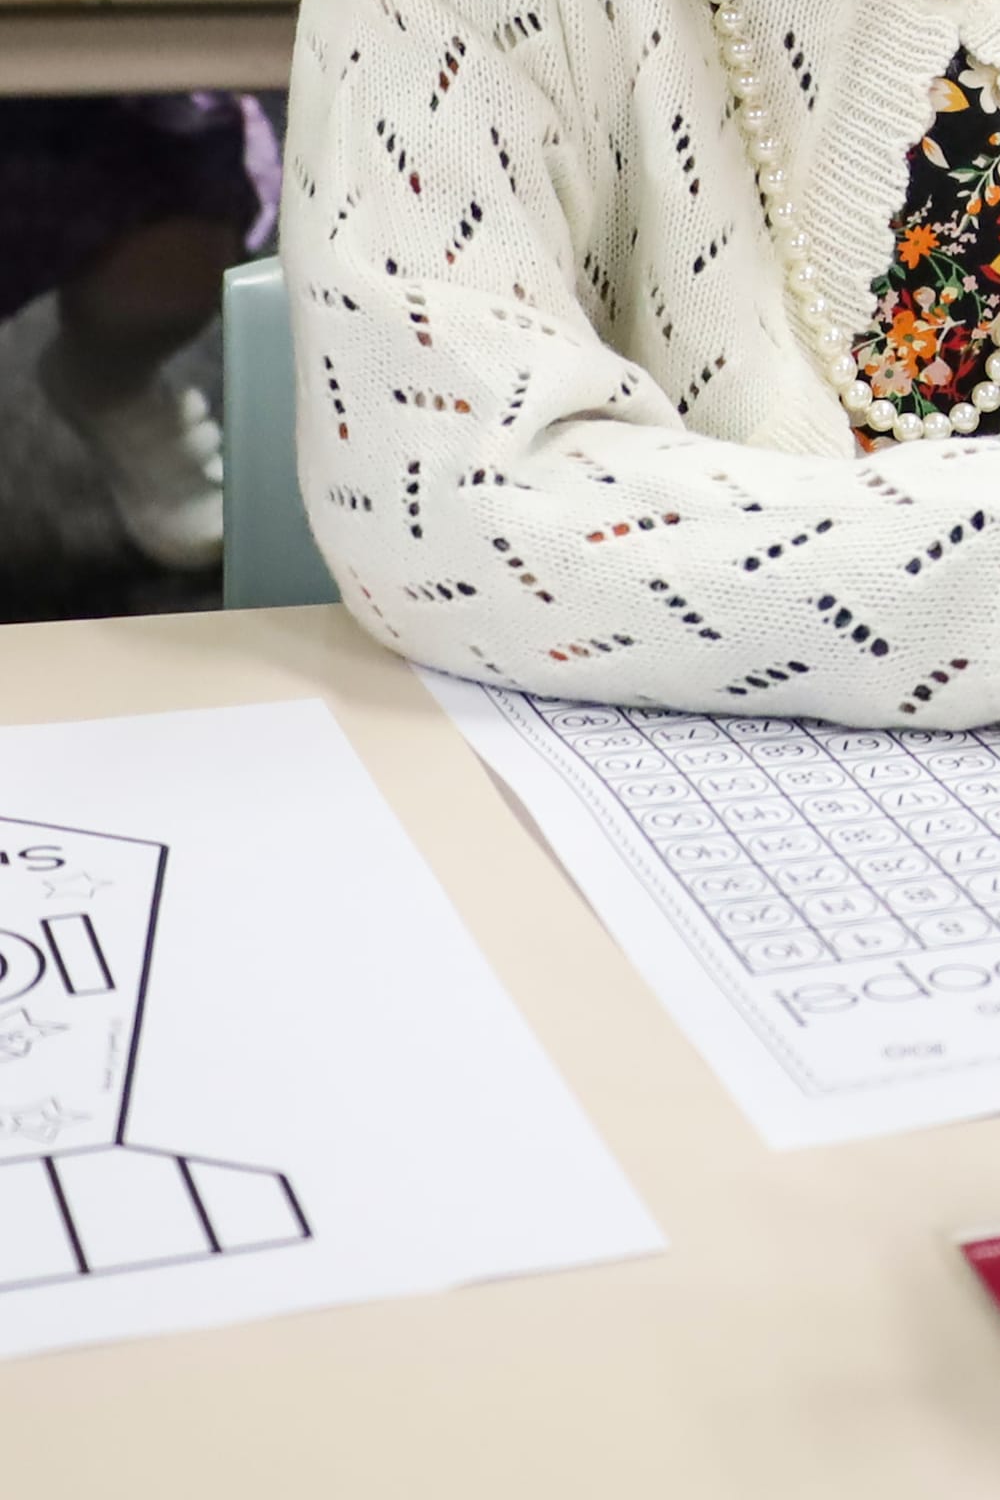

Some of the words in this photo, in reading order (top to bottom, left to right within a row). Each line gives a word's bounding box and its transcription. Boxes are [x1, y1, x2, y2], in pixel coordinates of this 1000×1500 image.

[562, 715, 609, 727] 90
[736, 720, 782, 733] 78
[660, 728, 708, 742] 79
[584, 737, 631, 748] 80
[843, 739, 880, 751] 67
[760, 744, 804, 757] 68
[604, 757, 654, 769] 70
[683, 752, 728, 765] 69
[938, 756, 984, 769] 56
[787, 771, 833, 784] 58
[871, 765, 909, 779] 57
[629, 785, 676, 798] 60
[708, 778, 756, 792] 59
[897, 793, 938, 807] 47
[812, 801, 860, 814] 48
[652, 813, 703, 828] 50
[732, 807, 781, 822] 49
